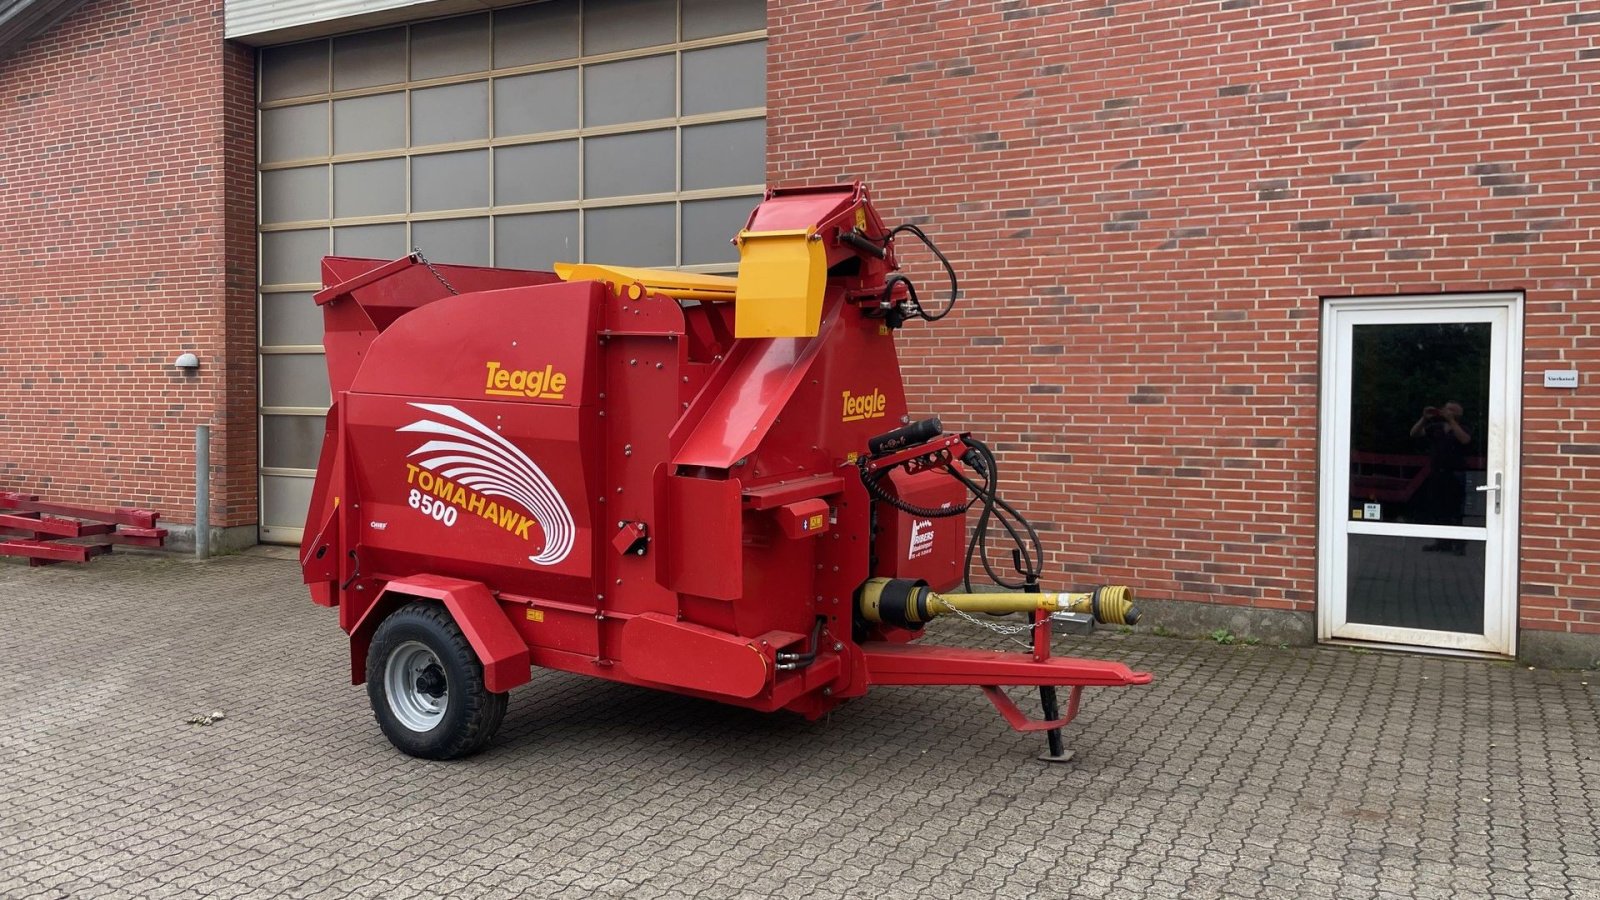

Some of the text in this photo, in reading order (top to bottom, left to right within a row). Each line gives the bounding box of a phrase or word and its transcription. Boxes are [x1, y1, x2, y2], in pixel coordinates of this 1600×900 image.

[486, 361, 567, 398] Teagle
[842, 388, 886, 419] Teagle
[406, 463, 536, 541] TOMAHAWK
[408, 489, 458, 527] 8500
